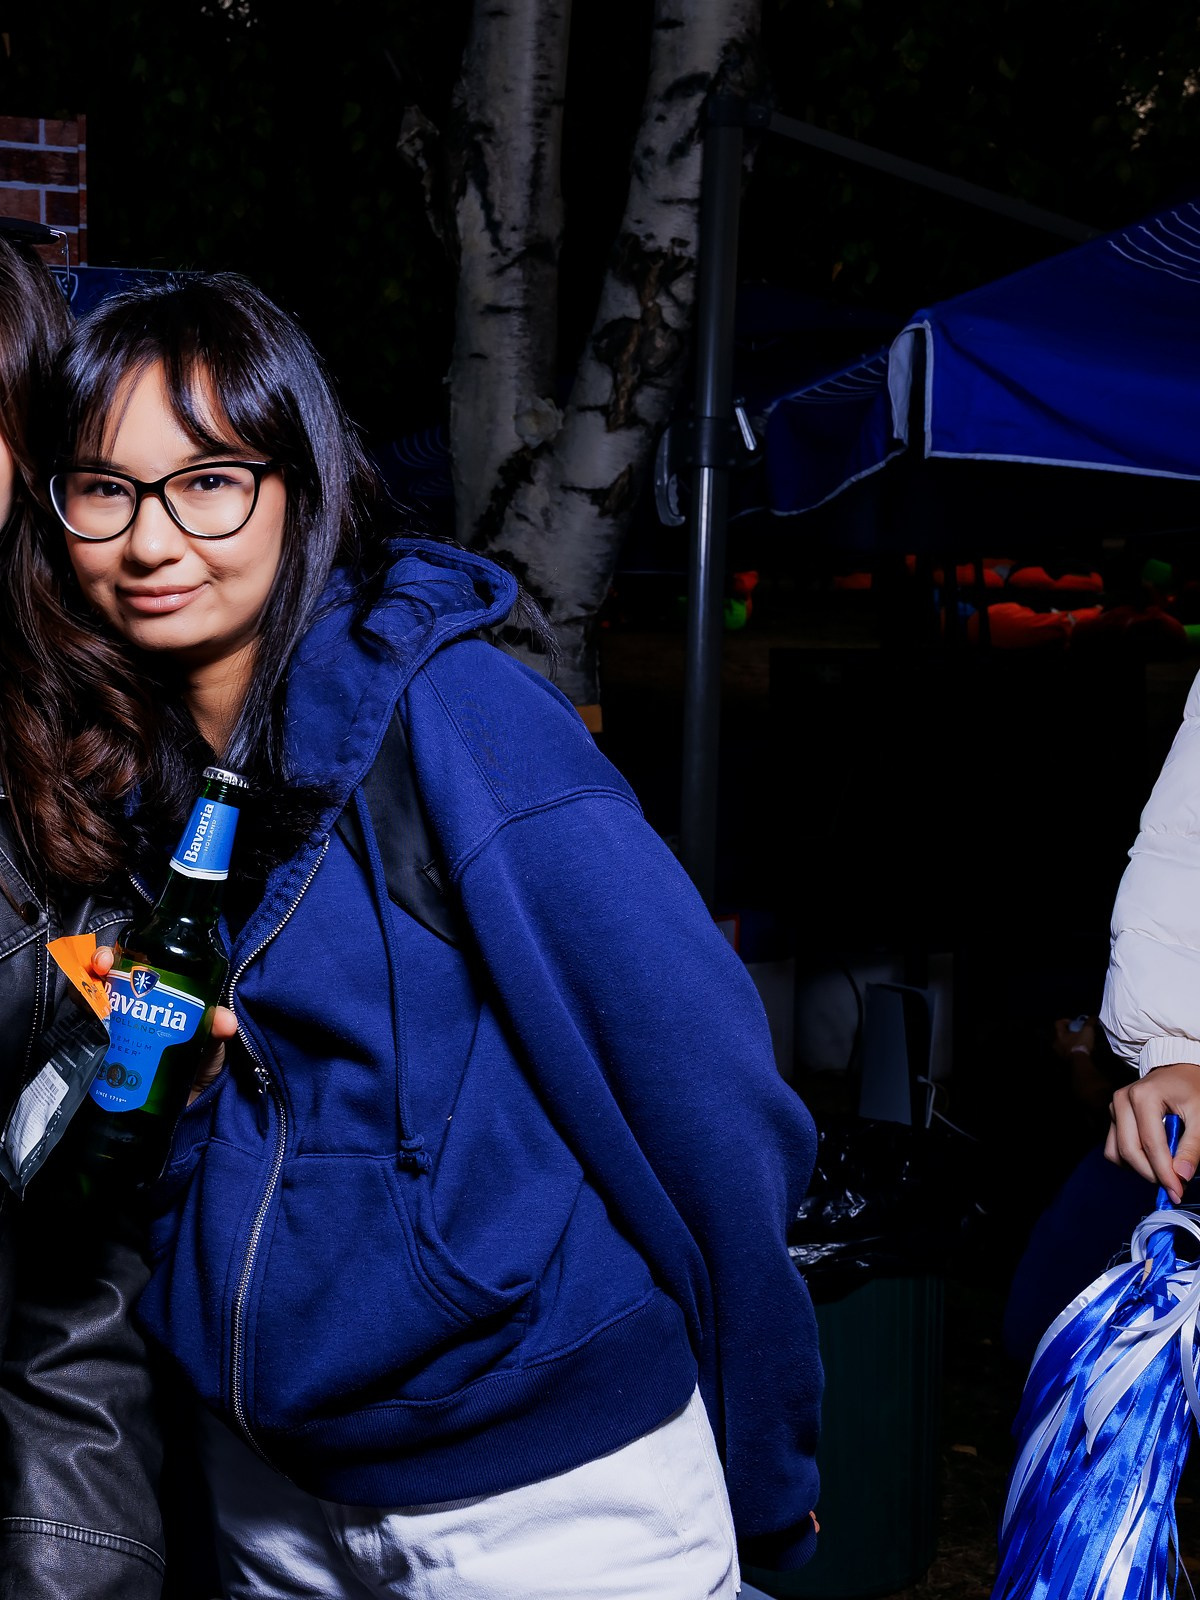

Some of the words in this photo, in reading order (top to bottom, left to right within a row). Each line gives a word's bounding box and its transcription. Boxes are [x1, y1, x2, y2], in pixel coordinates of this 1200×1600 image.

[183, 803, 215, 863] Bavaria
[204, 819, 217, 852] HOLLAND
[111, 1015, 156, 1035] HOLLAND
[111, 1033, 152, 1051] EMIUM
